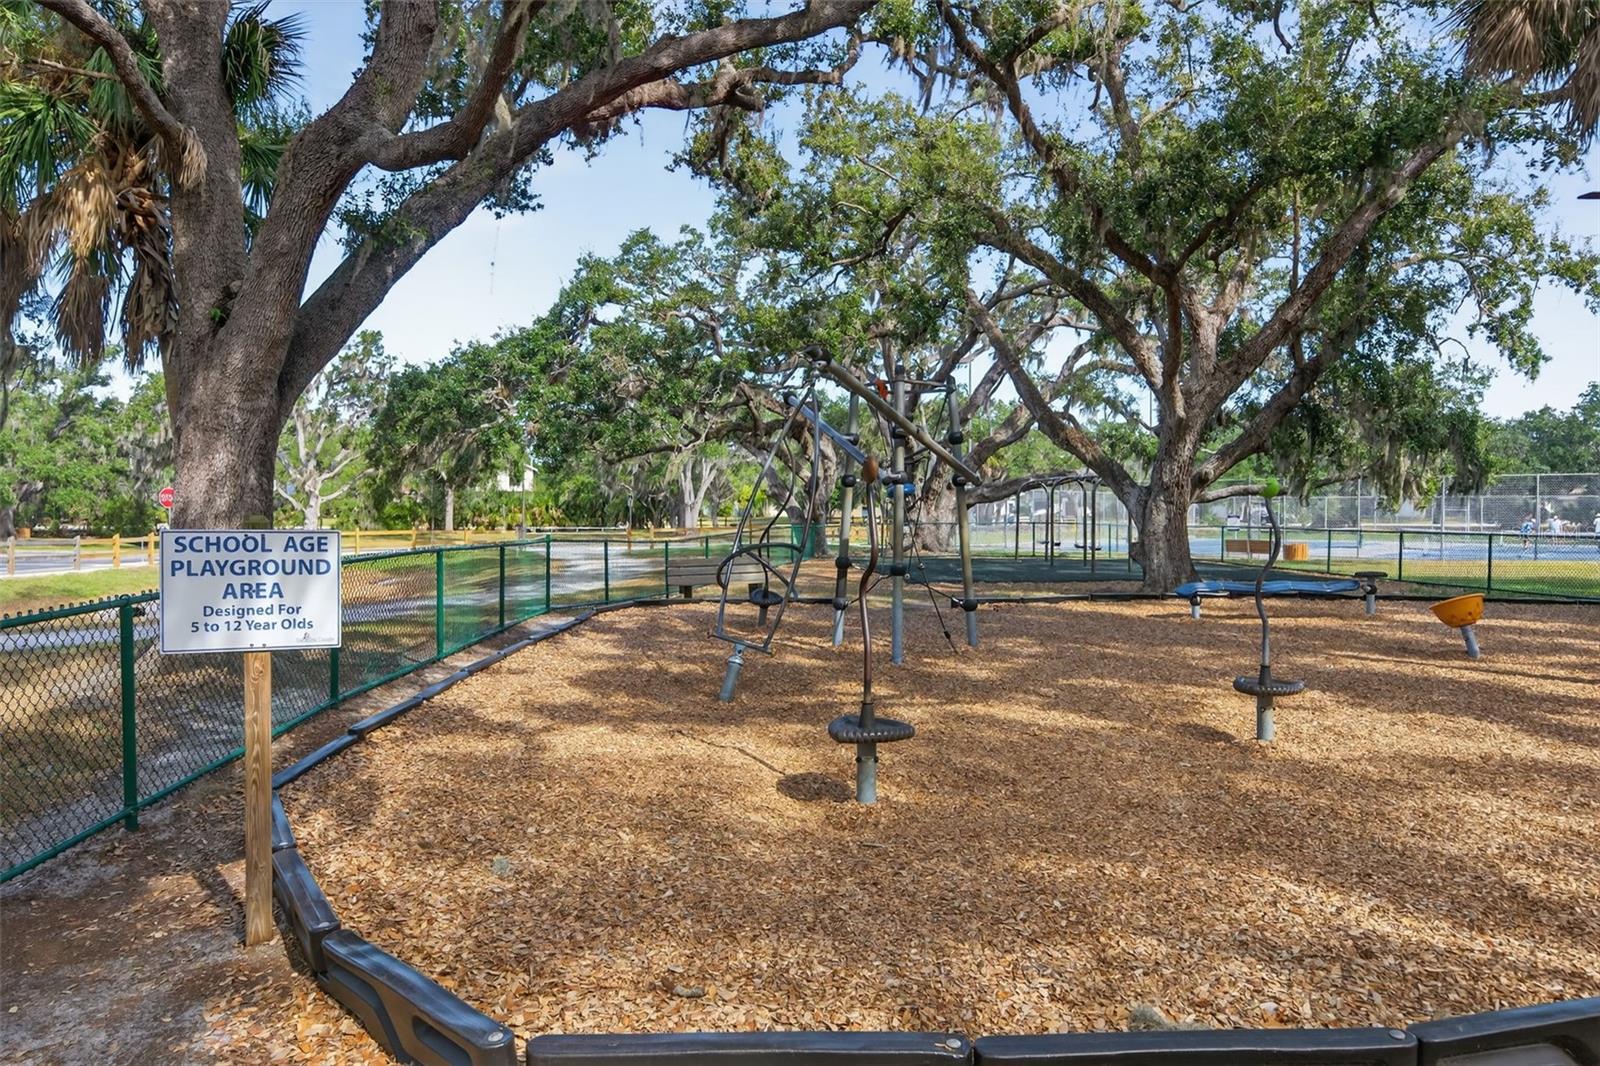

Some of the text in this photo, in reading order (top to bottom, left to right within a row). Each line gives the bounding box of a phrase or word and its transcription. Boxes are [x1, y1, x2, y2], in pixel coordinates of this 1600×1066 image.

[174, 535, 329, 553] SCHOOL AGE
[170, 558, 331, 577] PLAYGROUND
[222, 582, 284, 600] AREA
[203, 604, 302, 619] Designed For
[191, 617, 314, 633] 5 to 12 Year Olds
